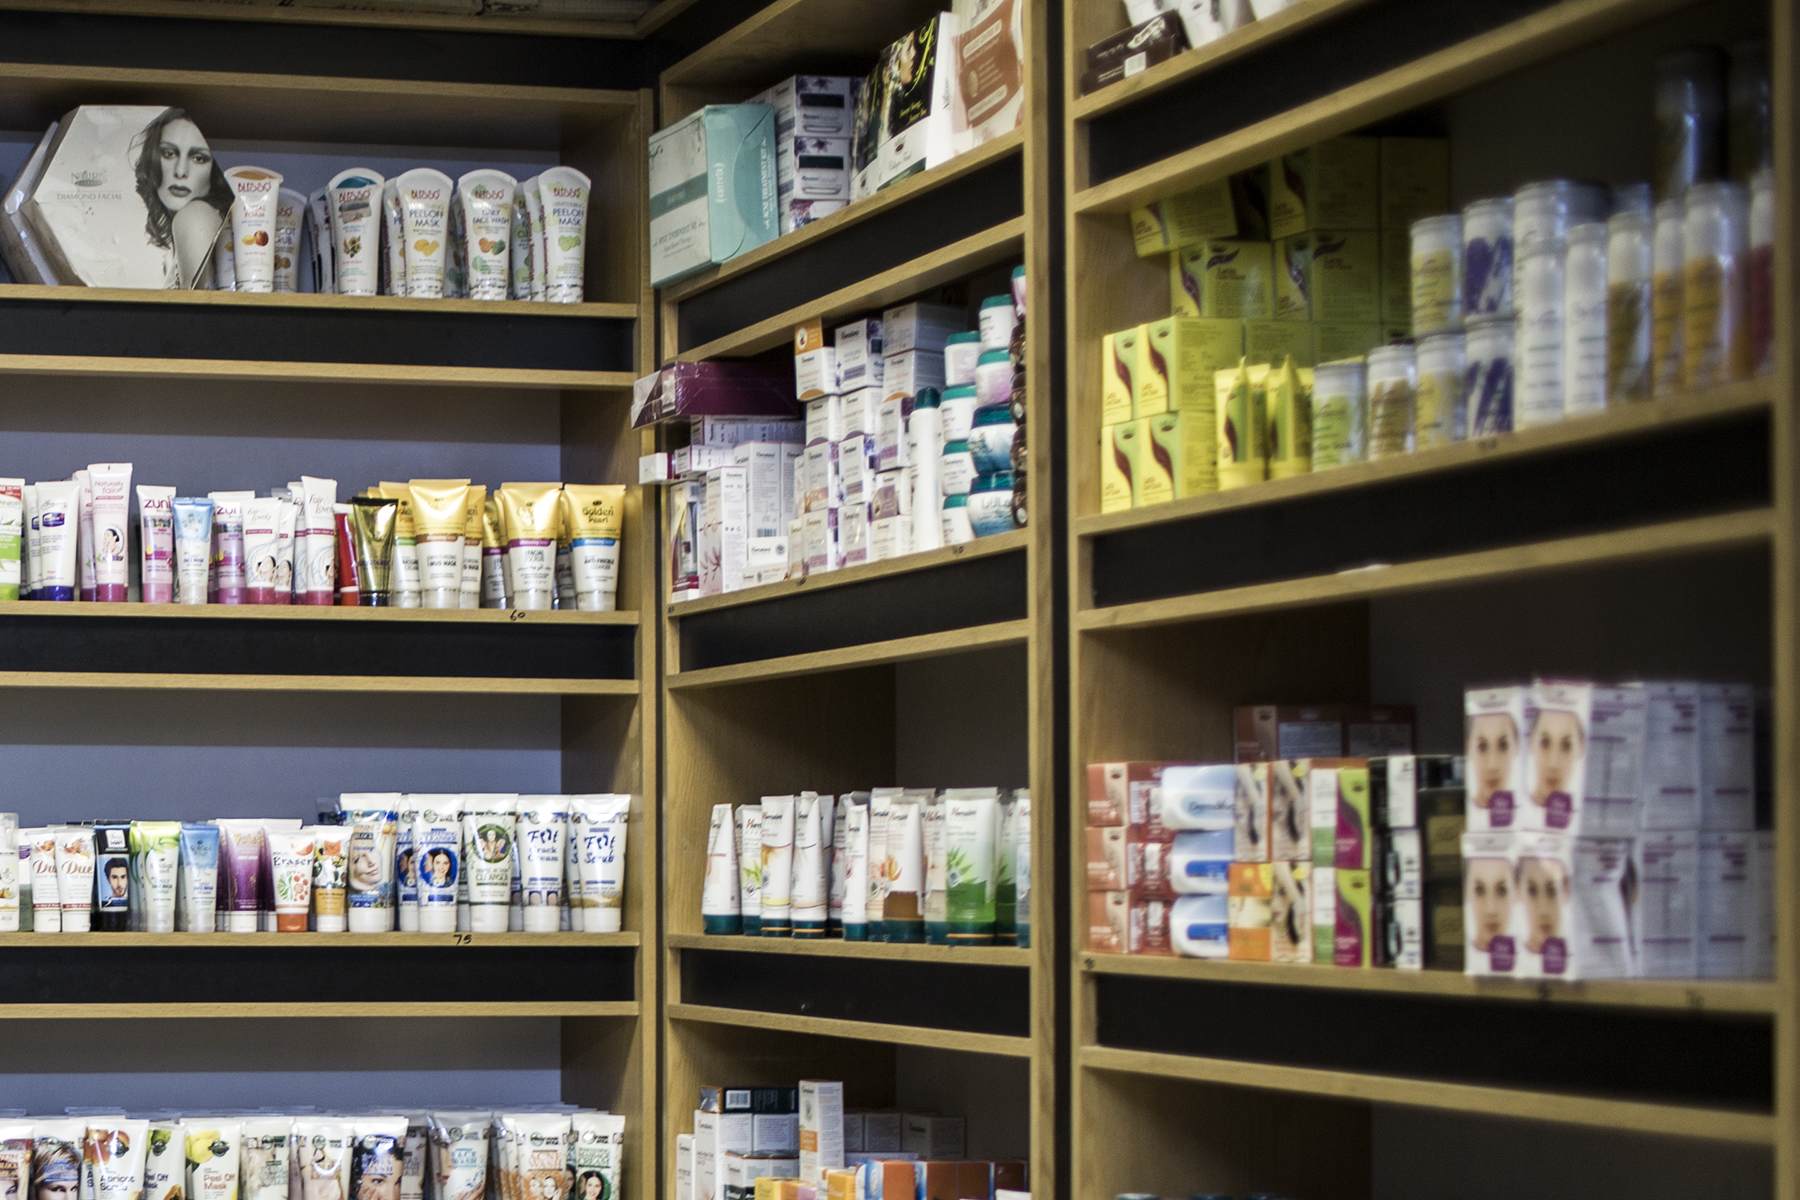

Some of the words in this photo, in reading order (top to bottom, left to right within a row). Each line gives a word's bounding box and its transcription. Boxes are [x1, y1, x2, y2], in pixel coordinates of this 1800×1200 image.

[414, 219, 440, 227] MASK
[559, 218, 582, 226] MASK
[582, 508, 614, 516] Golden
[272, 856, 313, 867] Eraser
[584, 851, 614, 864] Scrub
[453, 933, 472, 946] 75
[100, 1175, 135, 1185] Apricot
[203, 1173, 221, 1183] Peel
[222, 1173, 236, 1181] Off
